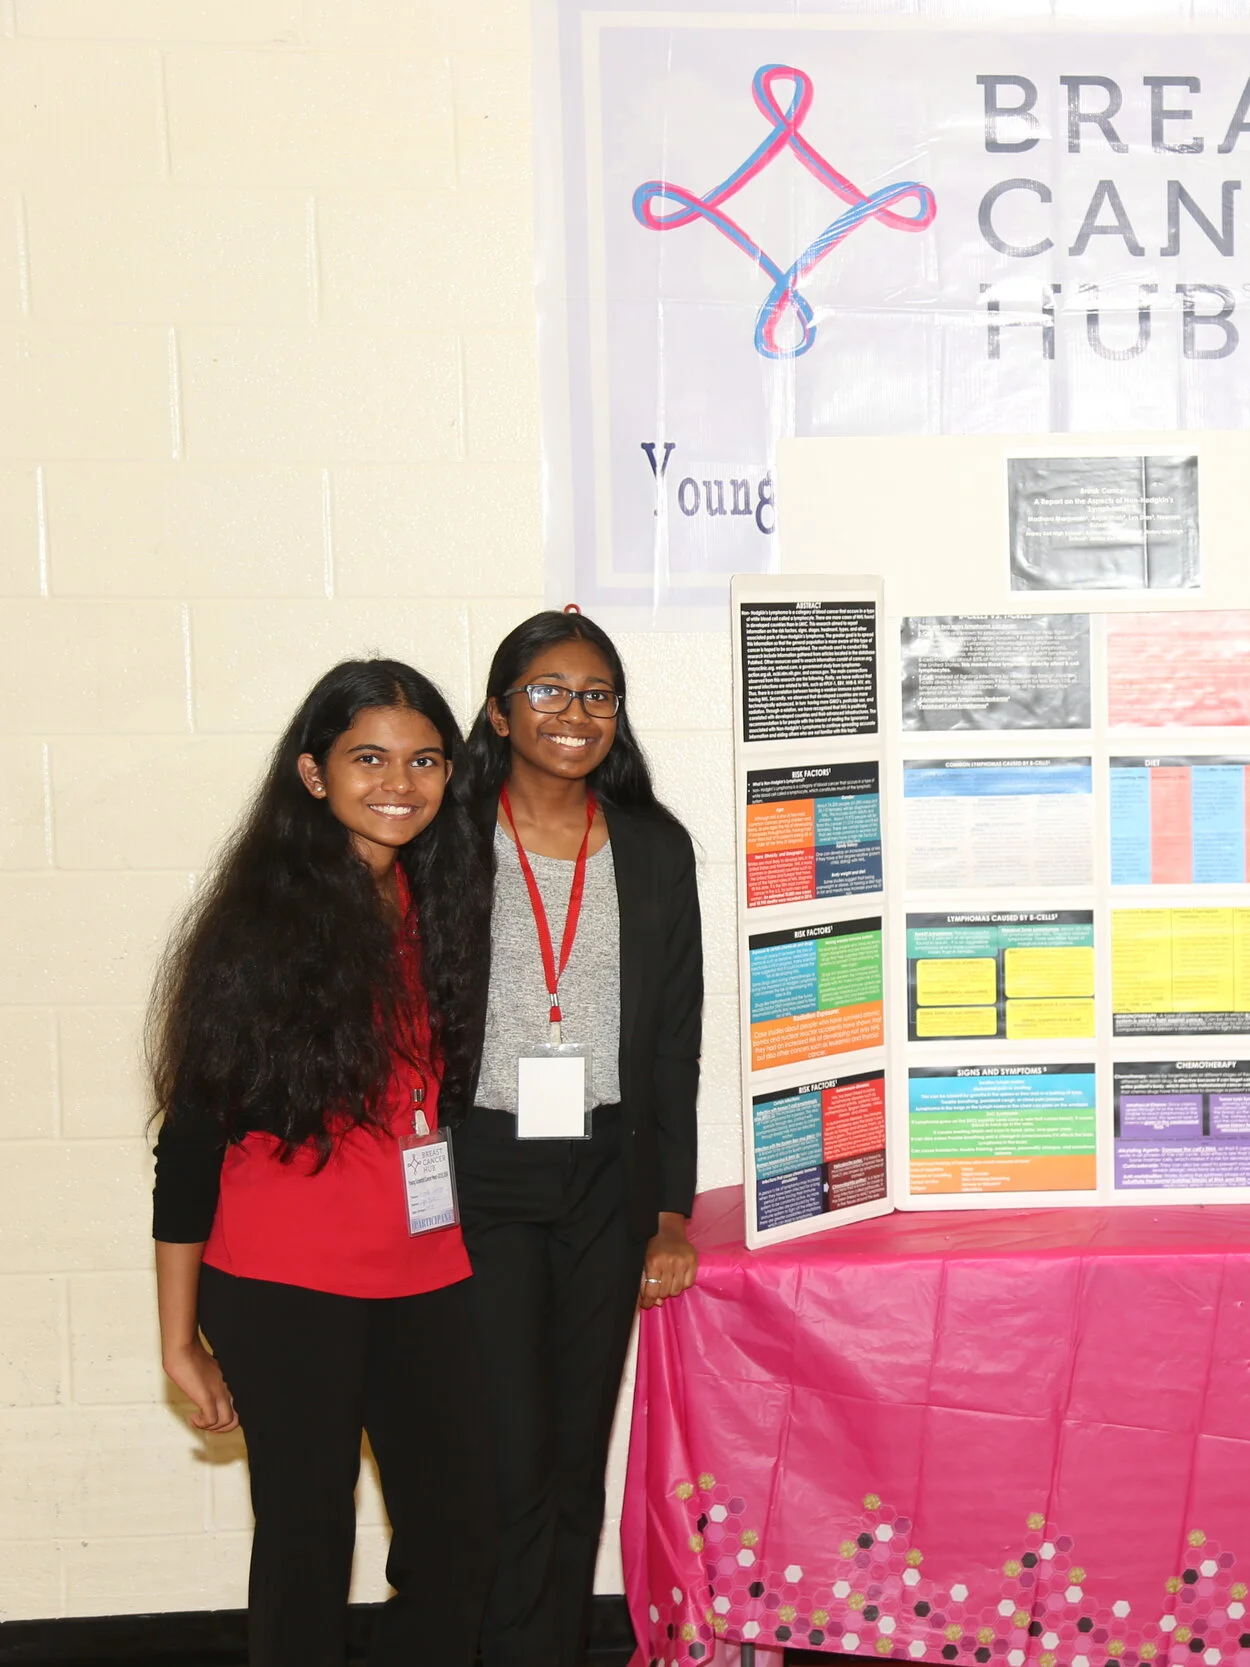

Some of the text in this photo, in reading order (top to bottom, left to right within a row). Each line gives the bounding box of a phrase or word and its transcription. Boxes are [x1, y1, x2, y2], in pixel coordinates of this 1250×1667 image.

[979, 283, 1240, 360] HUB
[1176, 1061, 1237, 1069] CHEMOTHERAPY
[1000, 1067, 1042, 1076] SYMPTOMS
[422, 1148, 442, 1158] BREAST
[423, 1155, 446, 1165] CANCER
